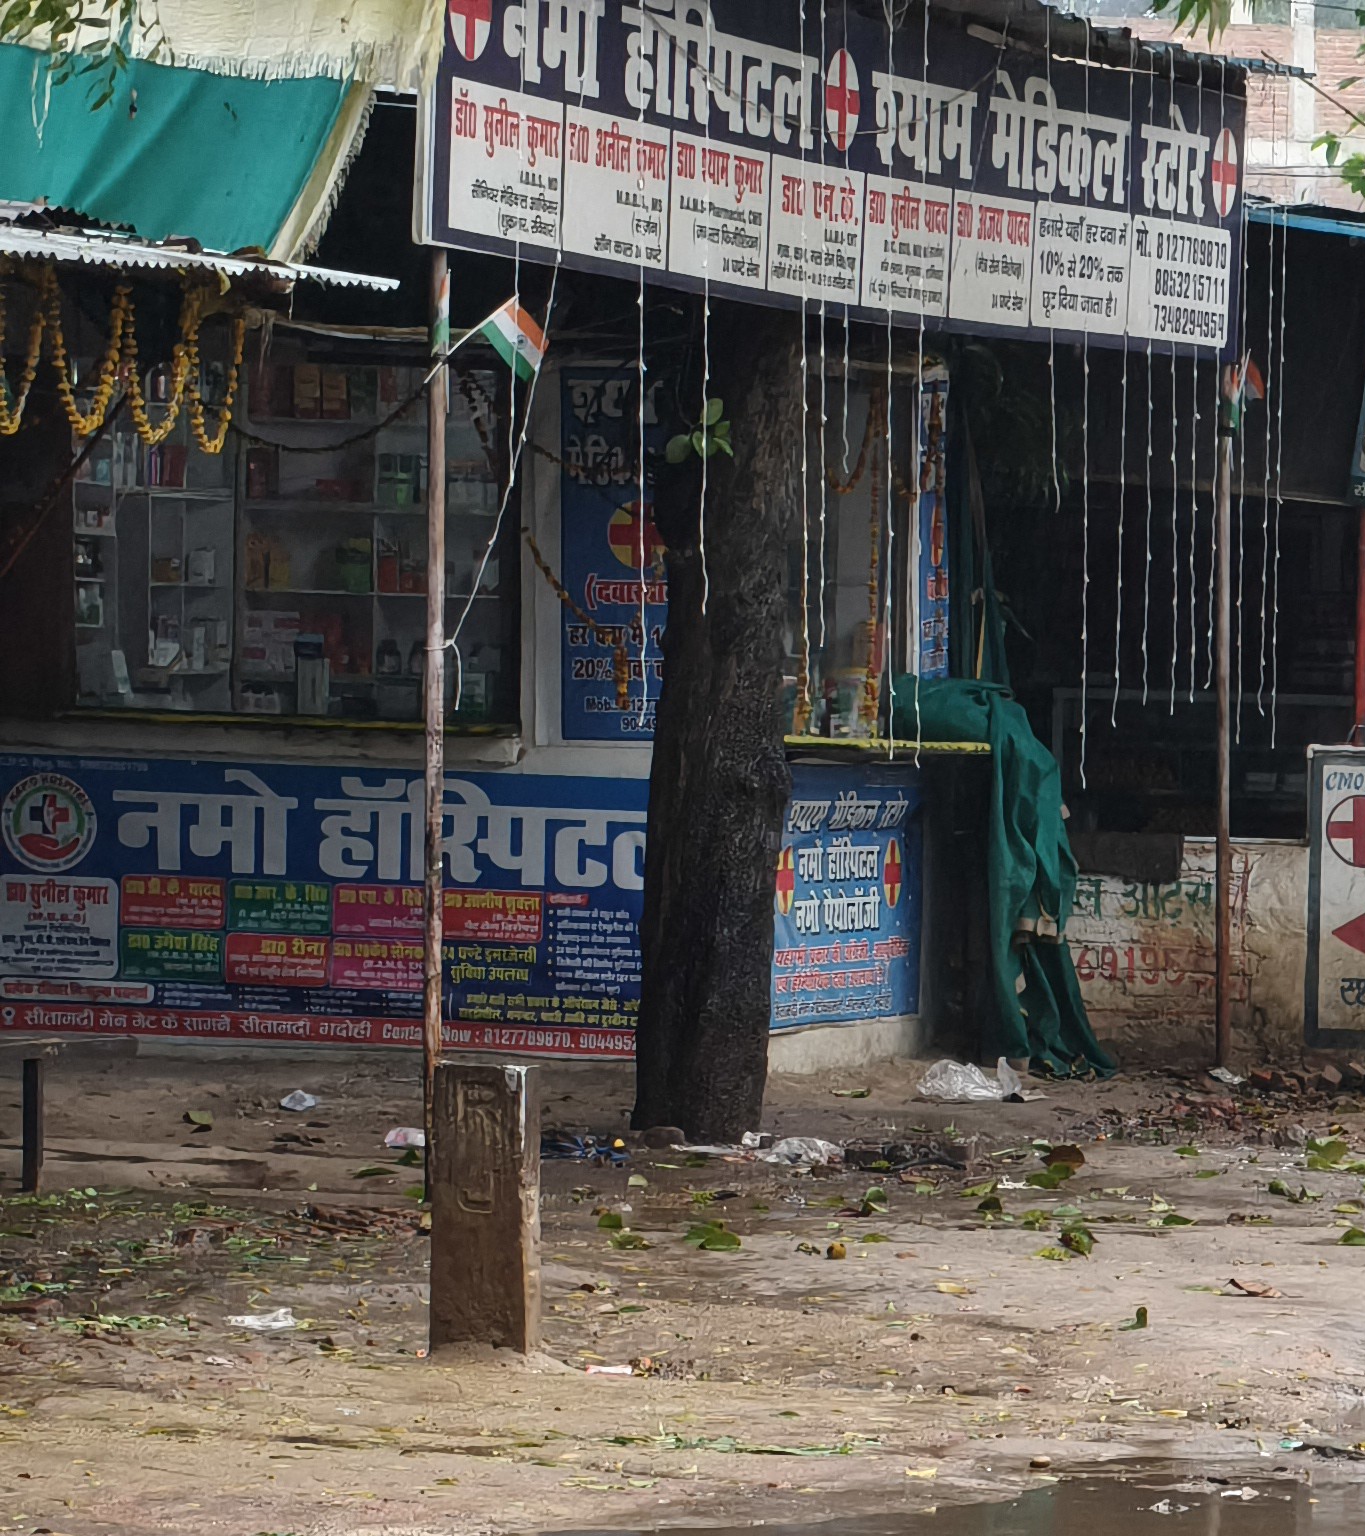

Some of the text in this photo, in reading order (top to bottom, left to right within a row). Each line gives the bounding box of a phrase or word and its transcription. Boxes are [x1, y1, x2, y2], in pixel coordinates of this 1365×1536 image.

[484, 98, 560, 167] सुनील कुमार
[871, 70, 977, 180] श्याम
[989, 70, 1131, 205] मेडिकल
[1141, 103, 1210, 218] स्टोर
[734, 155, 764, 204] कुमार
[925, 200, 949, 235] यादव
[1007, 210, 1030, 247] यादव
[1040, 213, 1063, 237] हमारे
[1086, 223, 1098, 243] हर
[1100, 227, 1116, 244] दवा
[1136, 221, 1226, 269] मो. 8127789870
[1040, 250, 1124, 283] 10% से 20% तक
[1043, 285, 1103, 318] छूट दिया जाता
[1326, 772, 1364, 791] CMO
[113, 769, 298, 874] नमो
[788, 791, 881, 831] श्याम मेडिकल
[826, 837, 880, 879] हॉस्पिटल
[794, 887, 880, 933] नमो पैथोलॉजी
[292, 938, 325, 955] रीना
[132, 1012, 157, 1028] गेट
[161, 1013, 178, 1029] के
